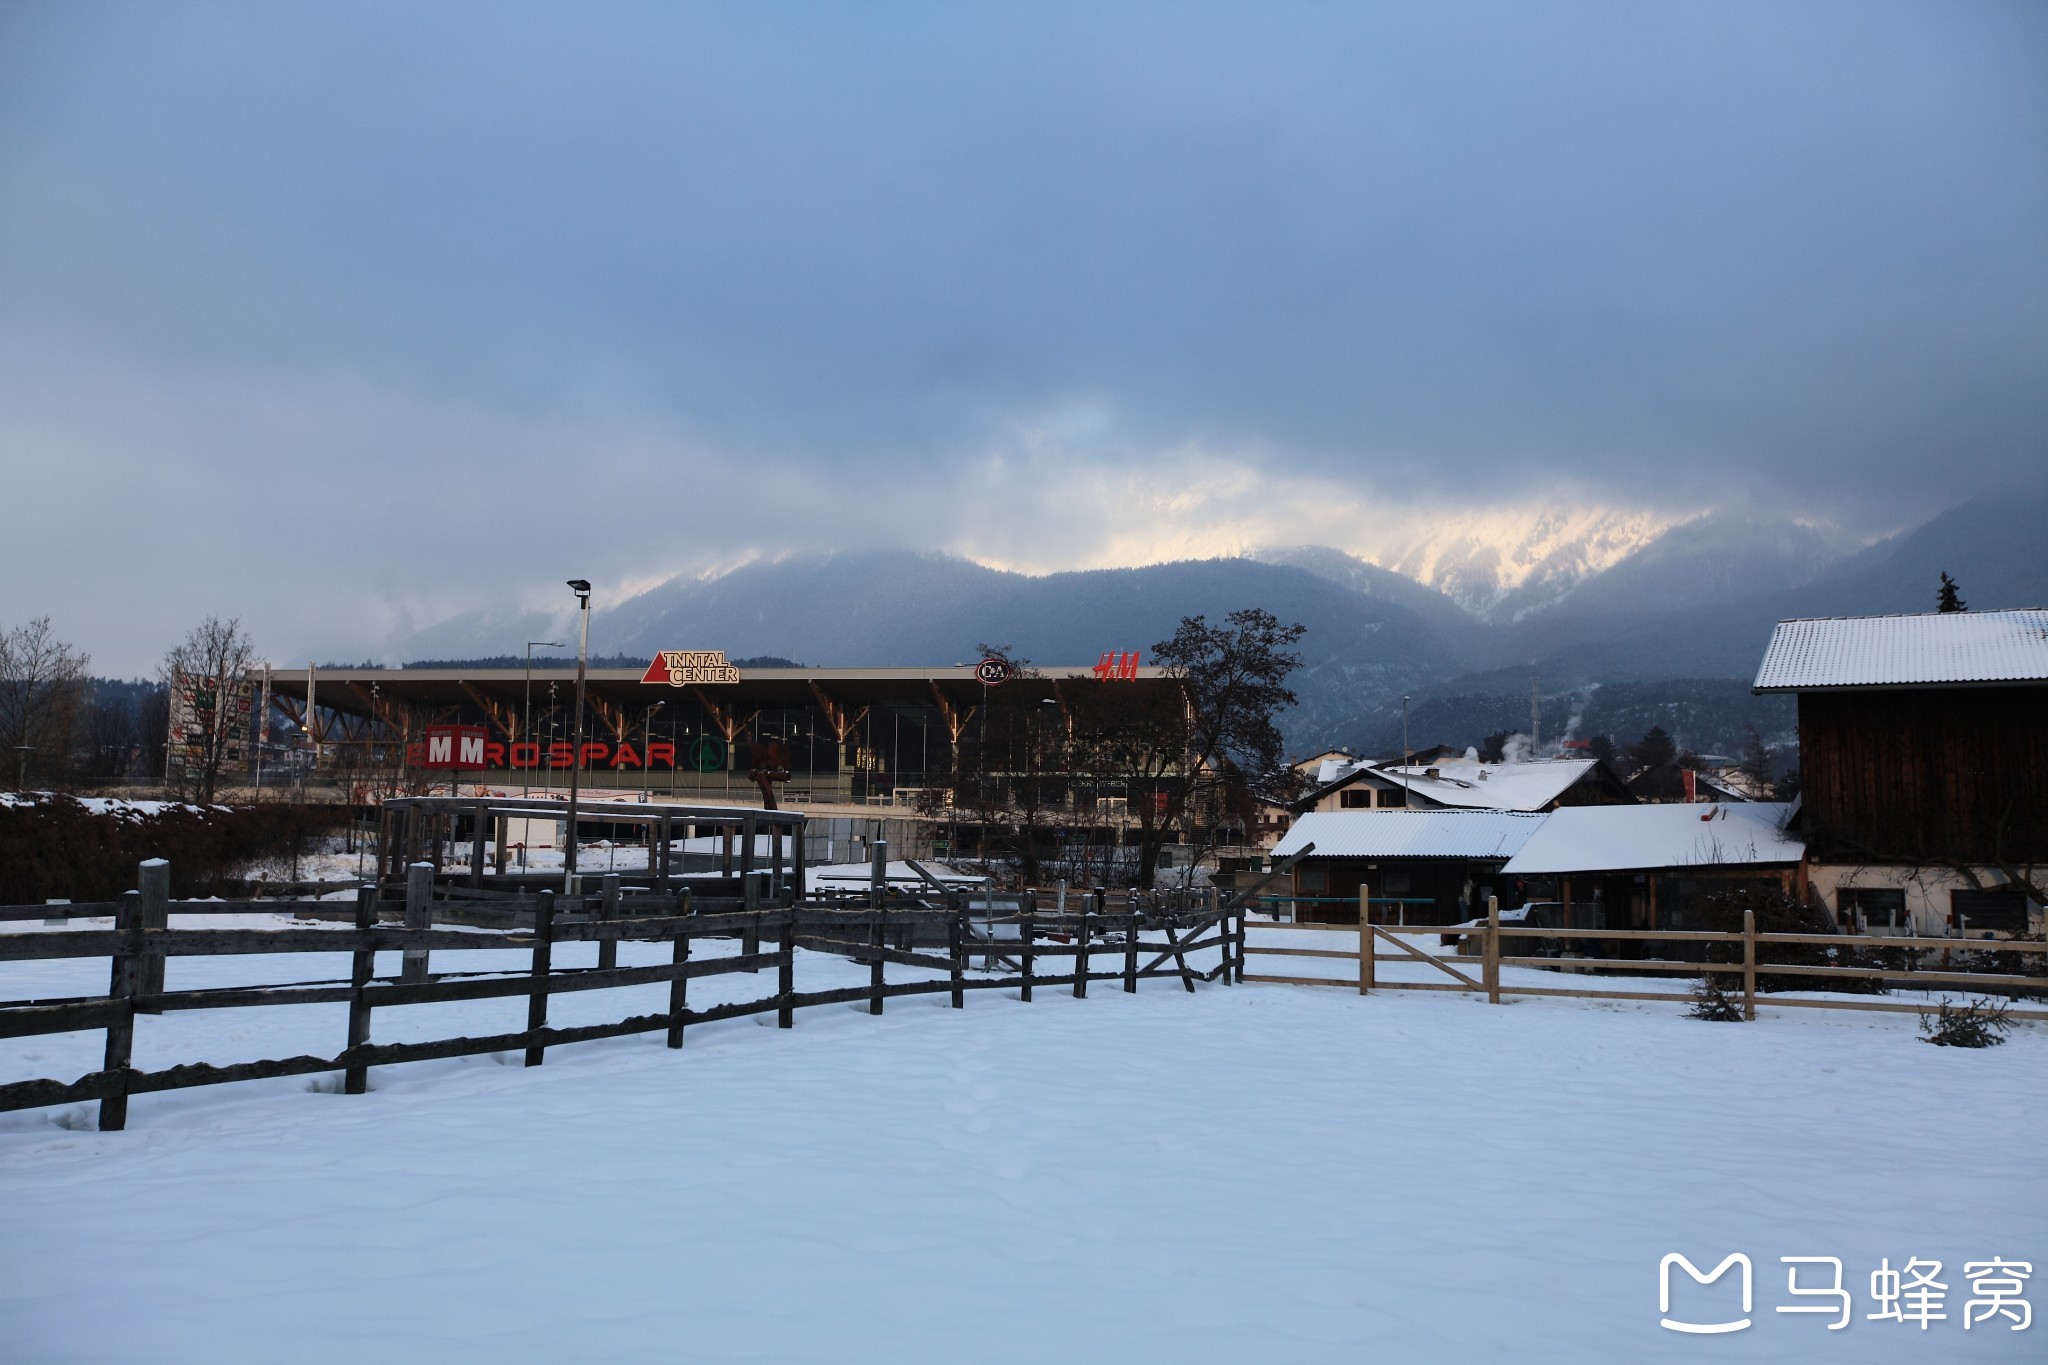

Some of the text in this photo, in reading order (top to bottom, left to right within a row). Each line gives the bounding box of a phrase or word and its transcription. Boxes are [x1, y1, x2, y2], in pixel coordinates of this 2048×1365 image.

[664, 652, 728, 670] INNTAL
[981, 665, 1005, 678] C&A
[1092, 650, 1140, 683] H&M
[670, 667, 738, 685] CENTER
[461, 730, 484, 738] SUPER
[407, 743, 675, 767] EROSPAR
[428, 736, 452, 763] M
[459, 736, 484, 764] M
